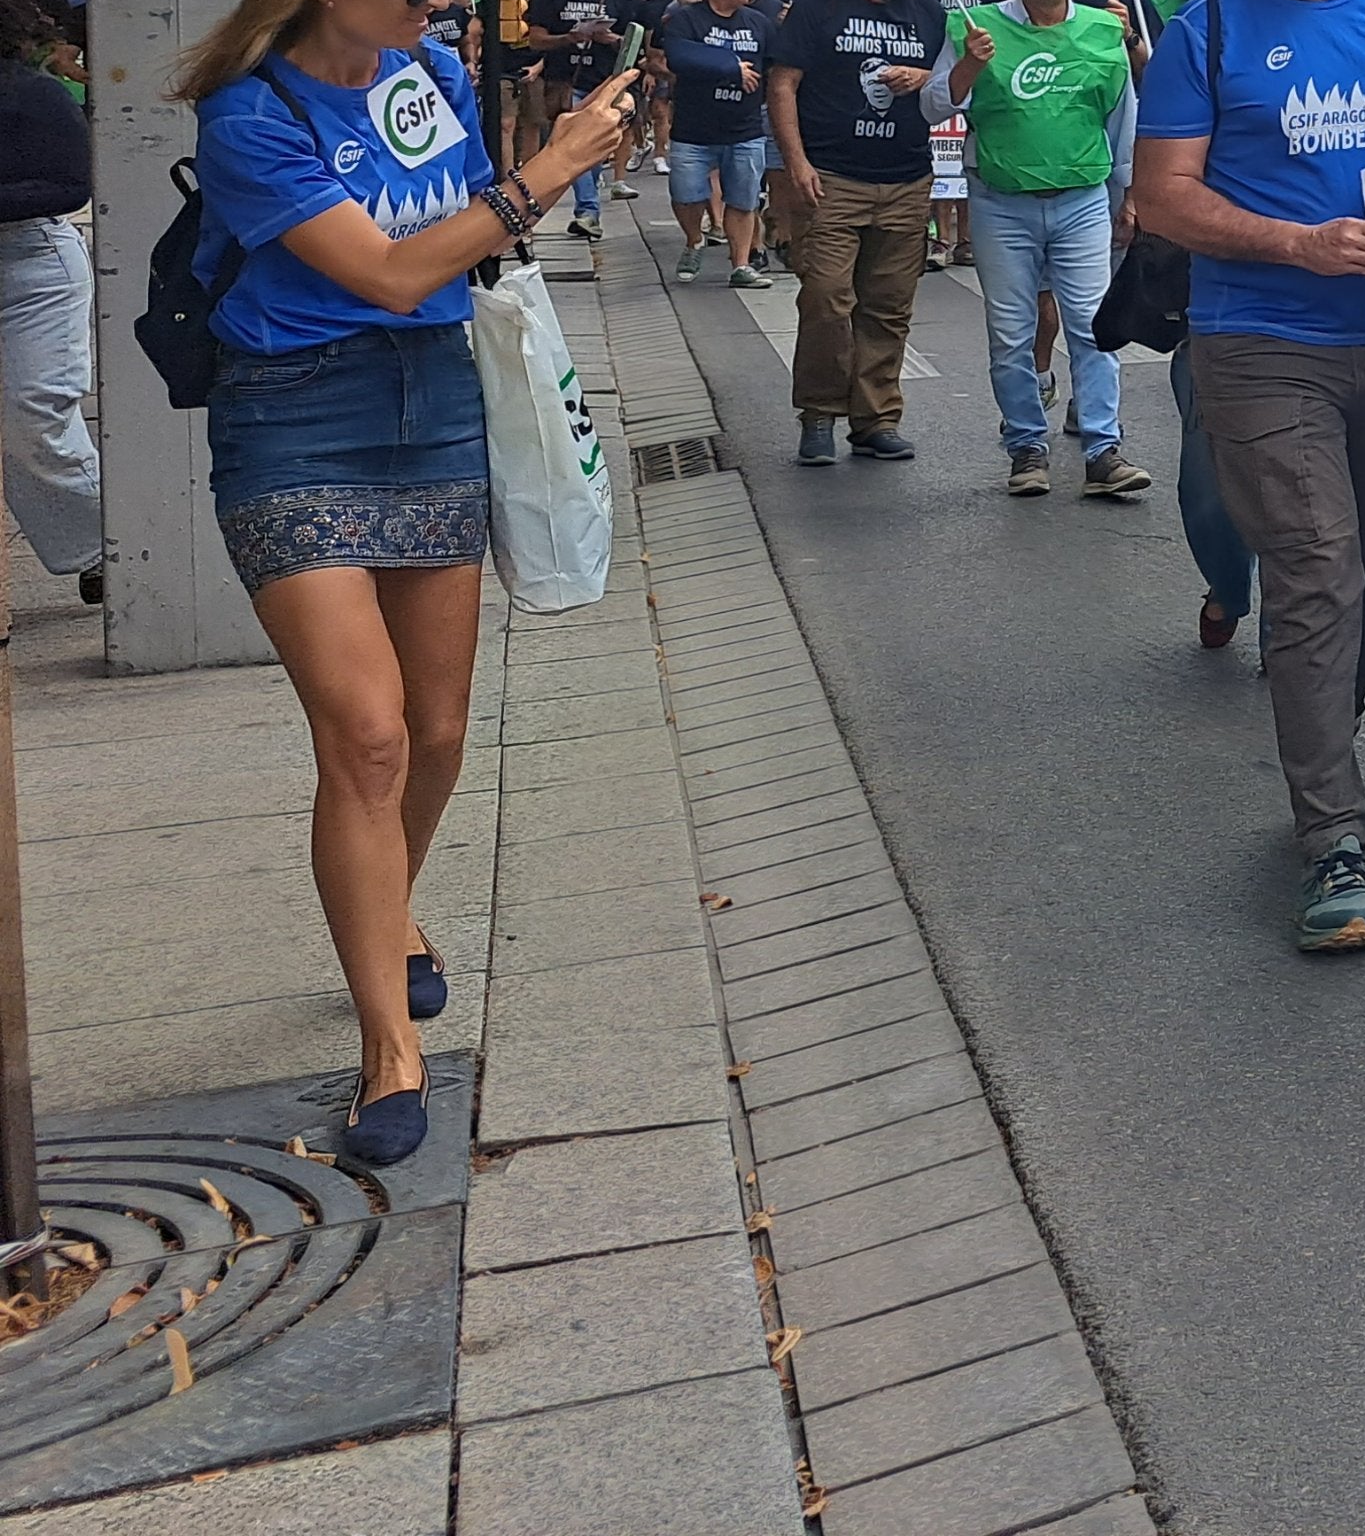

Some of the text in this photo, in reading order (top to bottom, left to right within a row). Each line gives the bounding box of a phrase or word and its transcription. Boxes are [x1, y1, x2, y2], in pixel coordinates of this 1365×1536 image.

[564, 1, 607, 14] JUANOTE
[835, 35, 925, 58] SOMOS TODOS
[1271, 50, 1294, 62] CSIF
[1021, 66, 1063, 84] CSIF
[714, 88, 742, 101] BO40
[395, 90, 437, 135] CSIF
[1288, 113, 1319, 130] CSIF
[854, 119, 896, 138] BO40
[338, 147, 367, 165] CSIF
